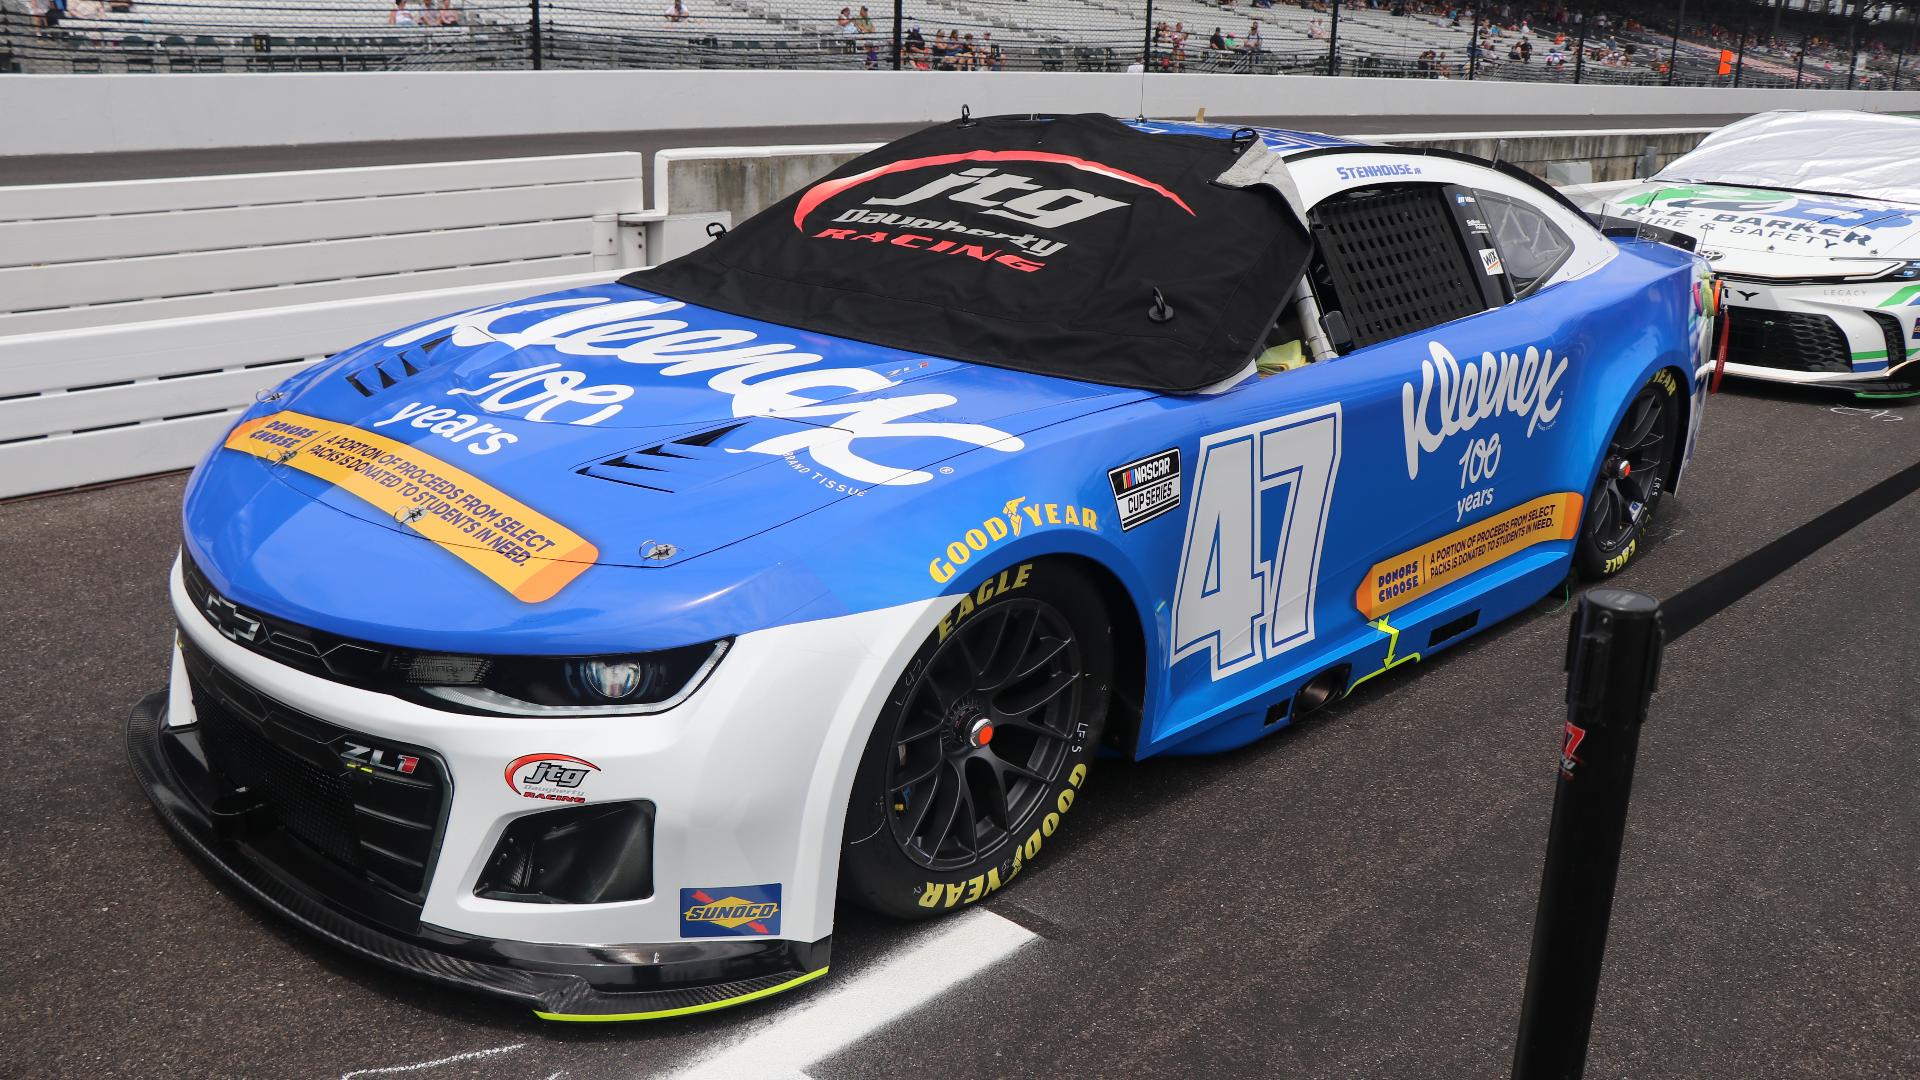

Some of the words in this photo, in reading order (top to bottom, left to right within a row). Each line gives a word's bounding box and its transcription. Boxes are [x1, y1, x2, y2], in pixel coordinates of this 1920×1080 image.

[1336, 164, 1413, 180] STENHOUSE
[862, 167, 1132, 229] jtg
[811, 228, 1047, 272] RACING
[831, 208, 1068, 257] Daugherty
[1730, 224, 1839, 249] SAFETY
[1483, 251, 1498, 266] WIX
[383, 297, 1026, 486] Kleenex
[447, 362, 634, 426] 100
[374, 402, 518, 455] years
[1402, 341, 1568, 480] Kleenex
[249, 430, 301, 449] CHOOSE
[265, 421, 318, 439] DONORS
[1134, 457, 1171, 484] NASCAR
[1458, 433, 1501, 489] 100
[325, 435, 336, 444] A
[334, 435, 386, 461] PORTION
[378, 453, 402, 468] OF
[394, 460, 464, 500] PROCEEDS
[455, 493, 503, 523] FROM
[493, 516, 556, 552] SELECT
[811, 471, 868, 497] TISSUE
[1127, 494, 1145, 513] CUP
[1145, 482, 1172, 506] SERIES
[309, 444, 344, 463] PACKS
[339, 455, 352, 468] IS
[349, 460, 402, 488] DONATED
[400, 482, 420, 496] TO
[412, 491, 482, 534] STUDENTS
[473, 527, 497, 543] IN
[489, 536, 531, 567] NEED.
[1456, 487, 1494, 522] years
[1169, 402, 1342, 682] 47
[1430, 554, 1435, 563] A
[1436, 541, 1466, 563] PORTION
[1466, 536, 1478, 551] OF
[1476, 521, 1510, 544] PROCEEDS
[1510, 513, 1527, 529] FROM
[1527, 504, 1556, 521] SELECT
[1430, 559, 1451, 579] PACKS
[1451, 557, 1458, 569] IS
[1458, 547, 1487, 567] DONATED
[1487, 541, 1496, 552] TO
[1496, 527, 1526, 549] STUDENTS
[1525, 524, 1533, 535] IN
[1532, 517, 1554, 532] NEED.
[1378, 561, 1418, 588] DONORS
[1604, 538, 1636, 575] EAGLE
[938, 564, 1033, 643] EAGLE
[1378, 575, 1419, 602] CHOOSE
[340, 741, 420, 774] ZL1
[523, 762, 591, 788] jtg
[523, 784, 585, 797] Daugherty
[523, 791, 586, 803] RACING
[918, 763, 1087, 909] GOODYEAR
[687, 904, 776, 920] SUNOCO
